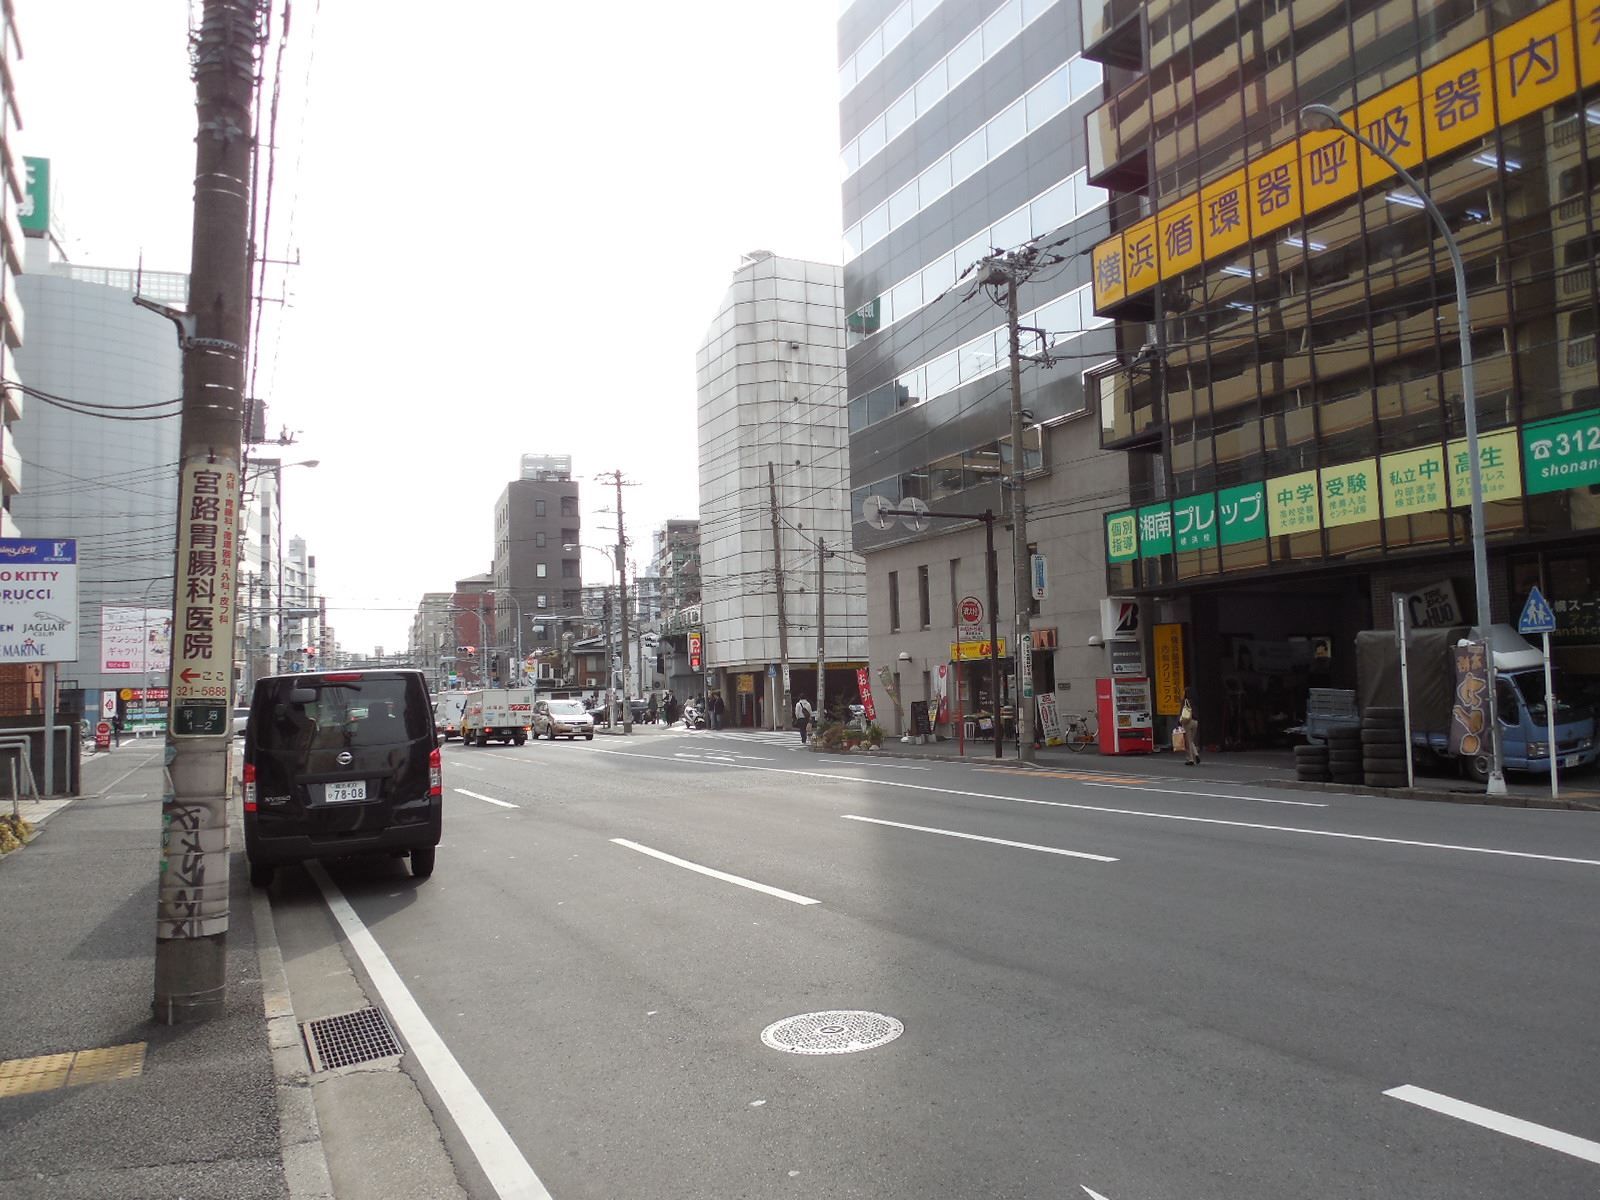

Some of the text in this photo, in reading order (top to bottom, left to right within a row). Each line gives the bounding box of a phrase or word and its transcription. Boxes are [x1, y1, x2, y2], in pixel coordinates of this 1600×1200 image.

[1096, 4, 1600, 293] 横浜循環器呼吸器内
[1390, 459, 1439, 486] 私立中
[1326, 473, 1367, 498] 受験
[1277, 483, 1314, 507] 中学
[1139, 491, 1262, 542] 湘南プレップ
[1111, 520, 1133, 537] 個別
[1111, 539, 1133, 553] 指導
[184, 469, 221, 660] 宮路胃腸科医院
[15, 571, 59, 582] KITTY
[0, 589, 51, 600] RUCCI
[22, 623, 66, 634] JAGUAR
[202, 671, 225, 682] ここ
[334, 788, 364, 800] 78-08
